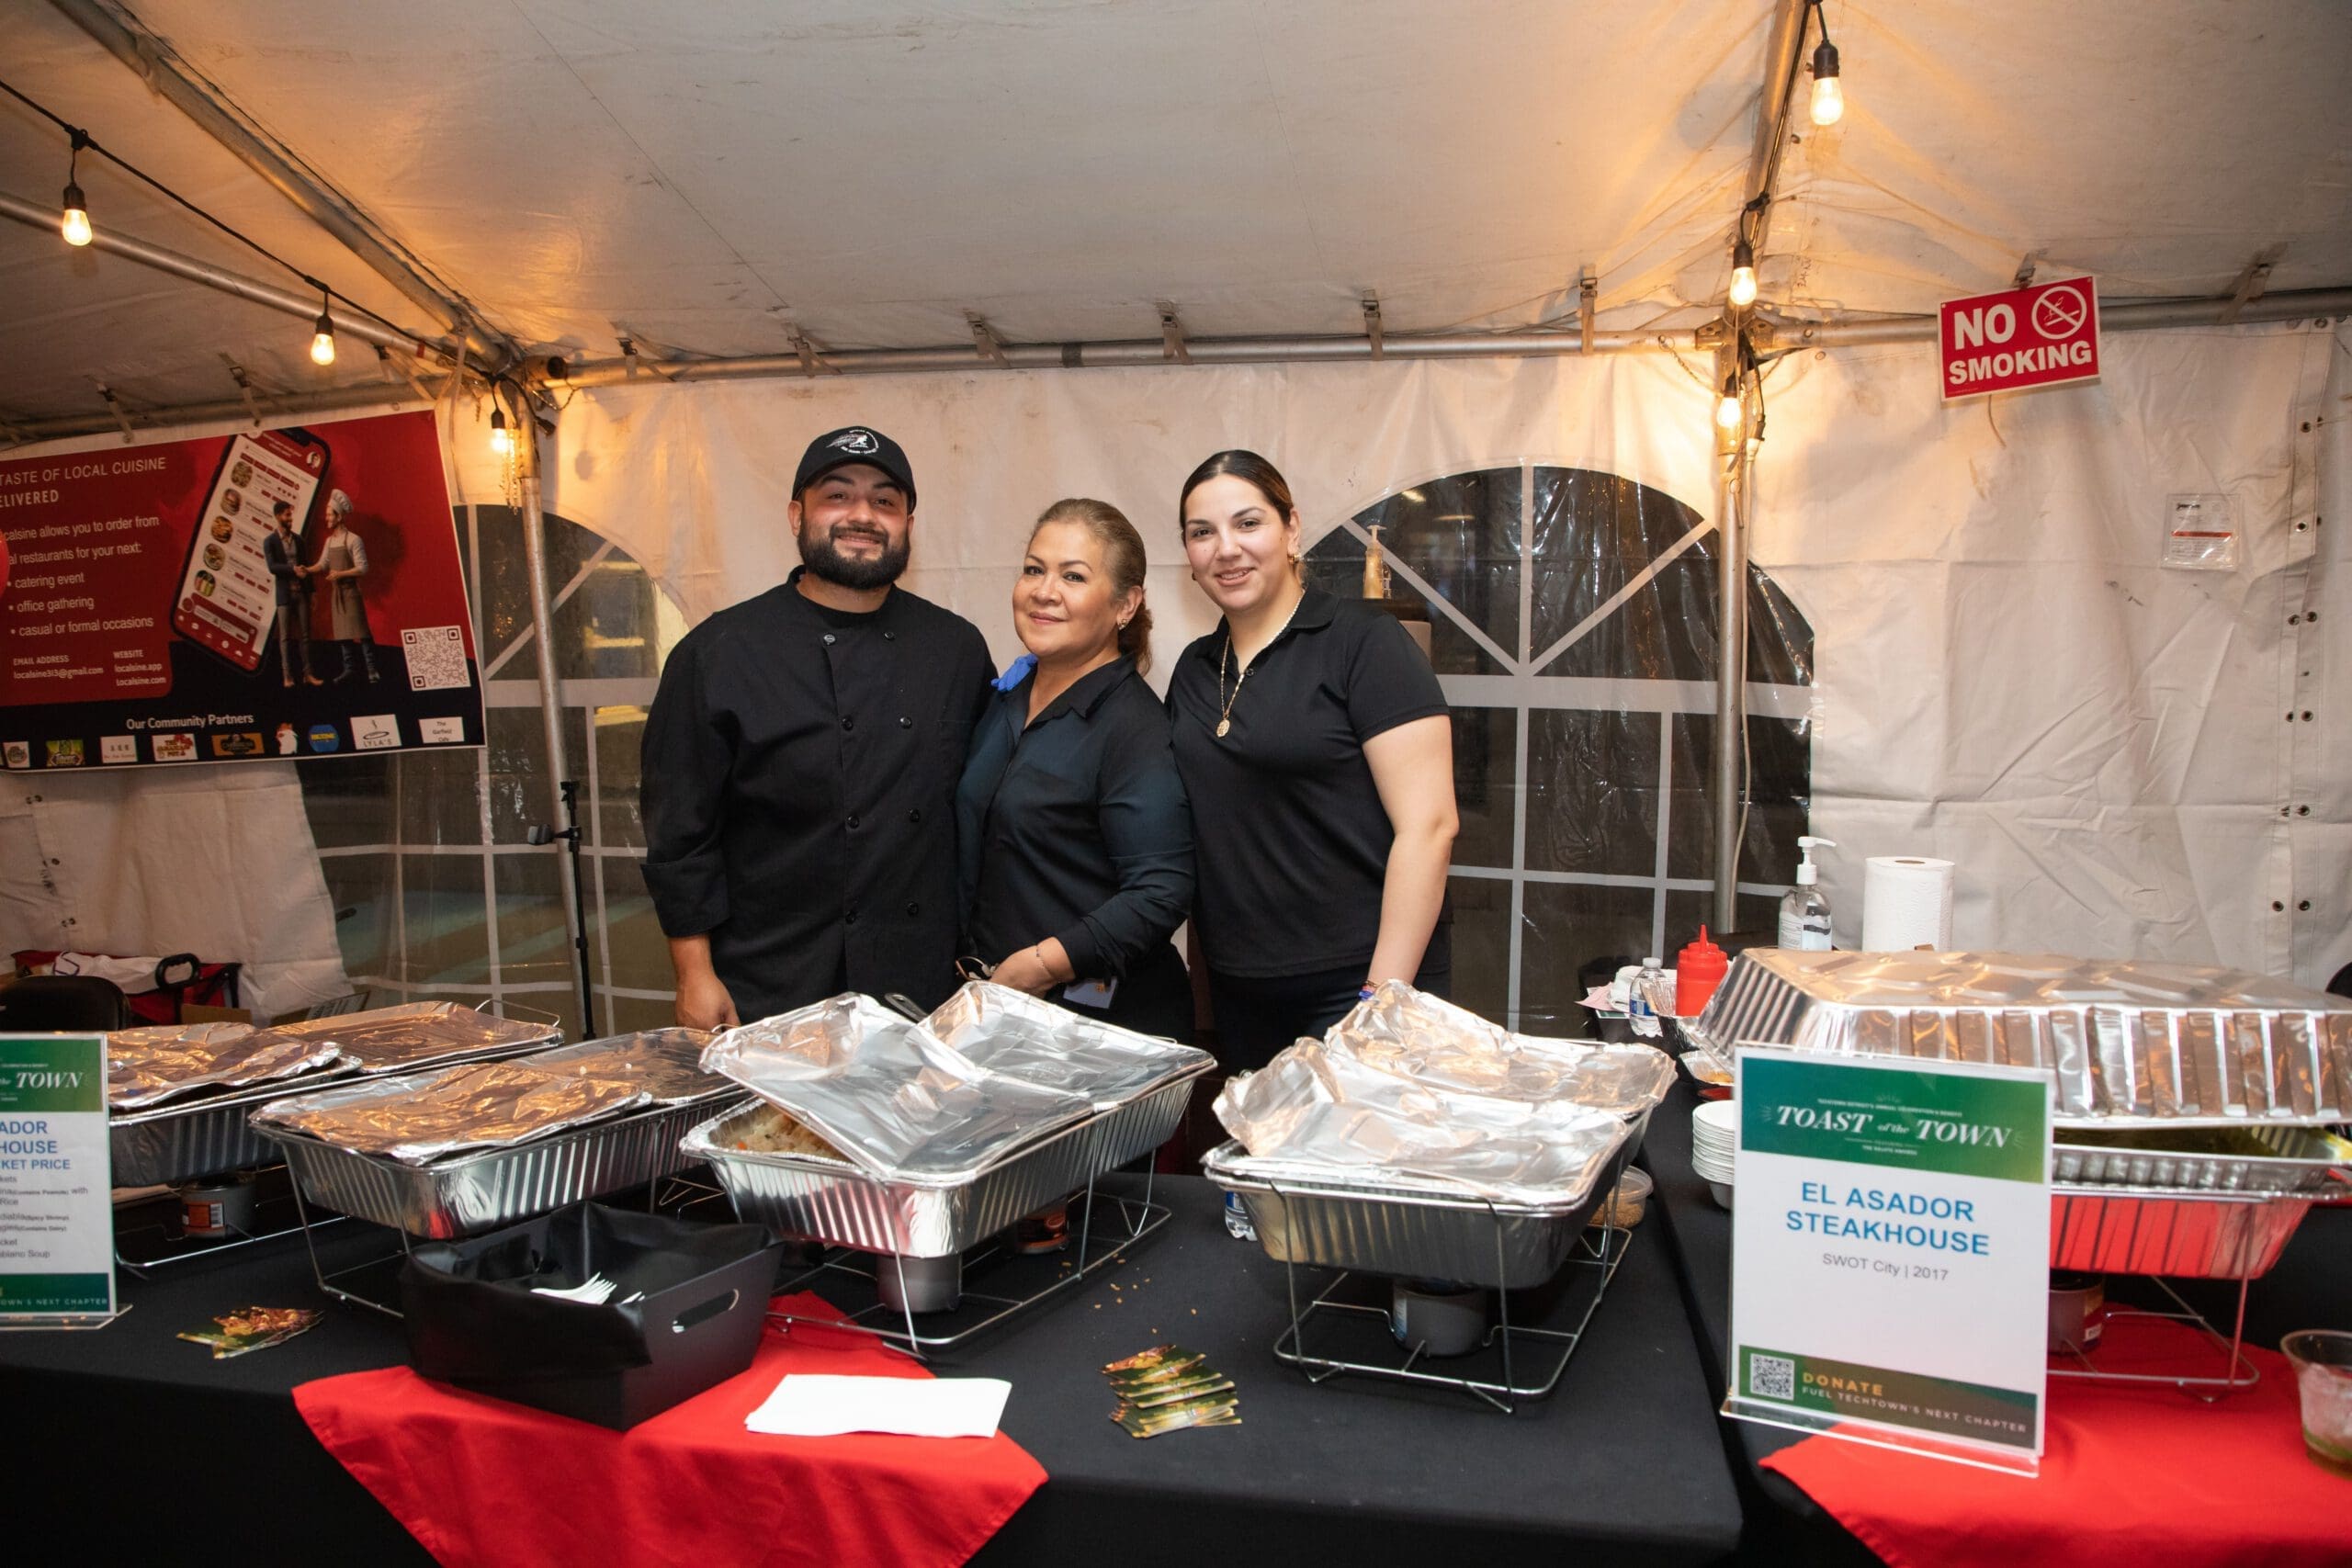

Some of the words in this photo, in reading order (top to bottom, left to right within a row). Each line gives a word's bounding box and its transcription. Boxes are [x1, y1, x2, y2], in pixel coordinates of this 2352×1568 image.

[1954, 303, 2016, 350] NO
[1949, 340, 2092, 385] SMOKING
[42, 468, 60, 481] OF
[65, 464, 107, 479] LOCAL
[112, 457, 166, 474] CUISINE
[40, 525, 70, 537] allows
[73, 524, 91, 537] you
[94, 522, 104, 533] to
[106, 517, 132, 530] order
[135, 515, 160, 527] from
[19, 549, 74, 564] restaurants
[76, 547, 90, 558] for
[92, 546, 114, 560] your
[117, 543, 142, 554] next:
[15, 575, 55, 589] catering
[57, 572, 85, 585] event
[17, 600, 44, 613] office
[48, 596, 95, 613] gathering
[19, 623, 52, 636] casual
[55, 624, 66, 634] or
[68, 619, 100, 633] formal
[102, 615, 154, 629] occasions
[13, 657, 35, 666] EMAIL
[36, 655, 70, 665] ADDRESS
[113, 649, 143, 659] WEBSITE
[126, 719, 145, 730] Our
[148, 715, 206, 728] Community
[208, 714, 254, 726] Partners
[17, 1072, 84, 1089] TOWN
[0, 1121, 48, 1134] ADOR
[1776, 1105, 1873, 1134] TOAST
[1877, 1122, 1891, 1133] of
[1891, 1123, 1910, 1134] the
[1915, 1119, 2014, 1148] TOWN
[2, 1159, 27, 1169] KET
[31, 1159, 71, 1169] PRICE
[1802, 1181, 1836, 1205] EL
[1846, 1188, 1974, 1222] ASADOR
[1786, 1211, 1990, 1256] STEAKHOUSE
[1823, 1253, 1868, 1272] SWOT
[1872, 1259, 1900, 1278] City
[1913, 1265, 1949, 1281] 2017
[1803, 1371, 1883, 1396] DONATE
[1802, 1387, 1832, 1400] FUEL
[1838, 1392, 1920, 1415] TECHTOWN'S
[1926, 1407, 1960, 1421] NEXT
[1964, 1415, 2027, 1433] CHAPTER
